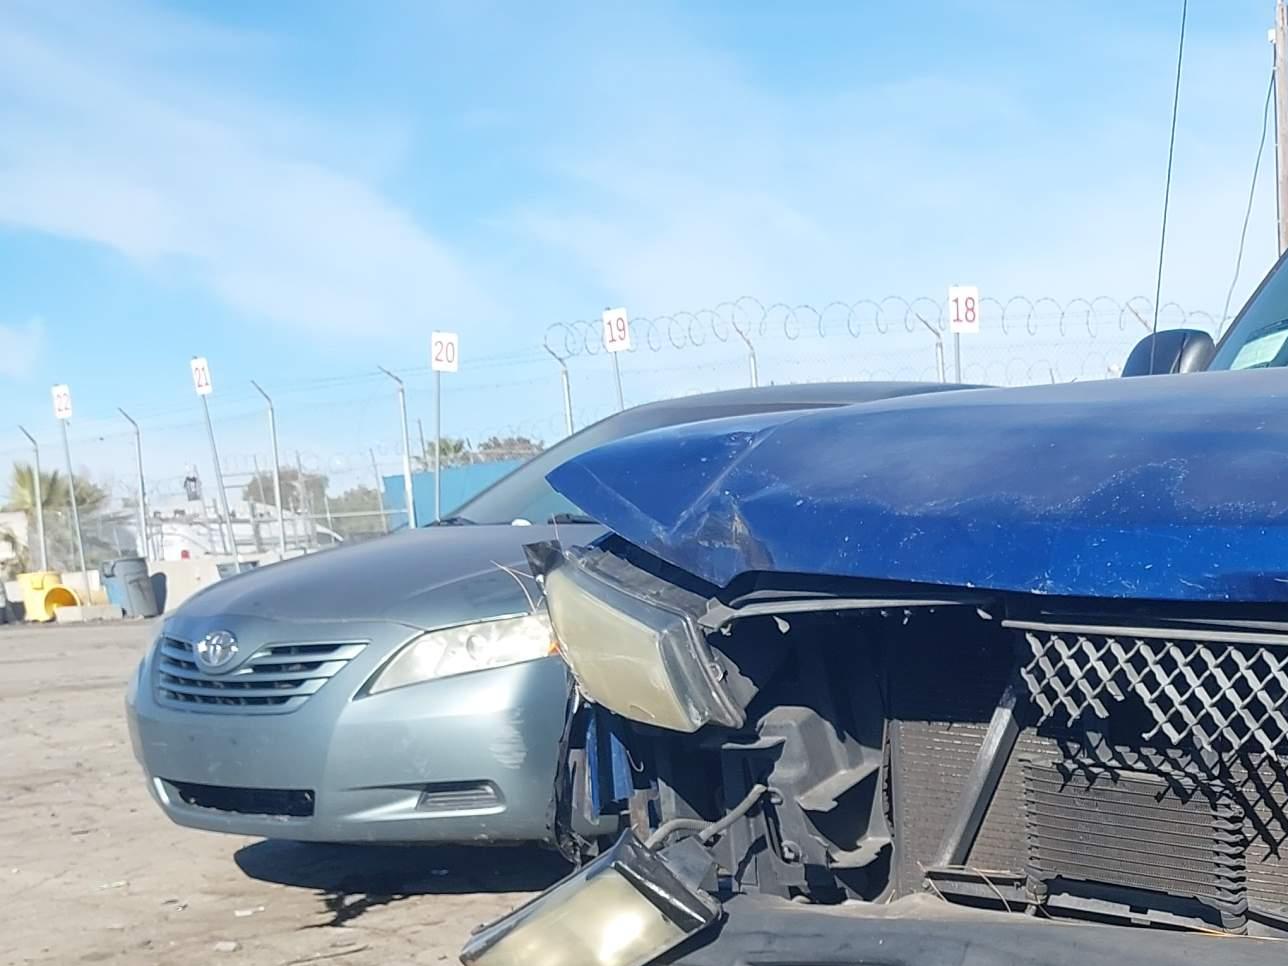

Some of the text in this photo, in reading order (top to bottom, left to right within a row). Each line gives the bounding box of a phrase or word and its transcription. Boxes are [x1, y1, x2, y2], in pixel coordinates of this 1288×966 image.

[951, 296, 976, 323] 18
[606, 317, 626, 343] 19
[434, 340, 455, 363] 20
[195, 366, 210, 388] 21
